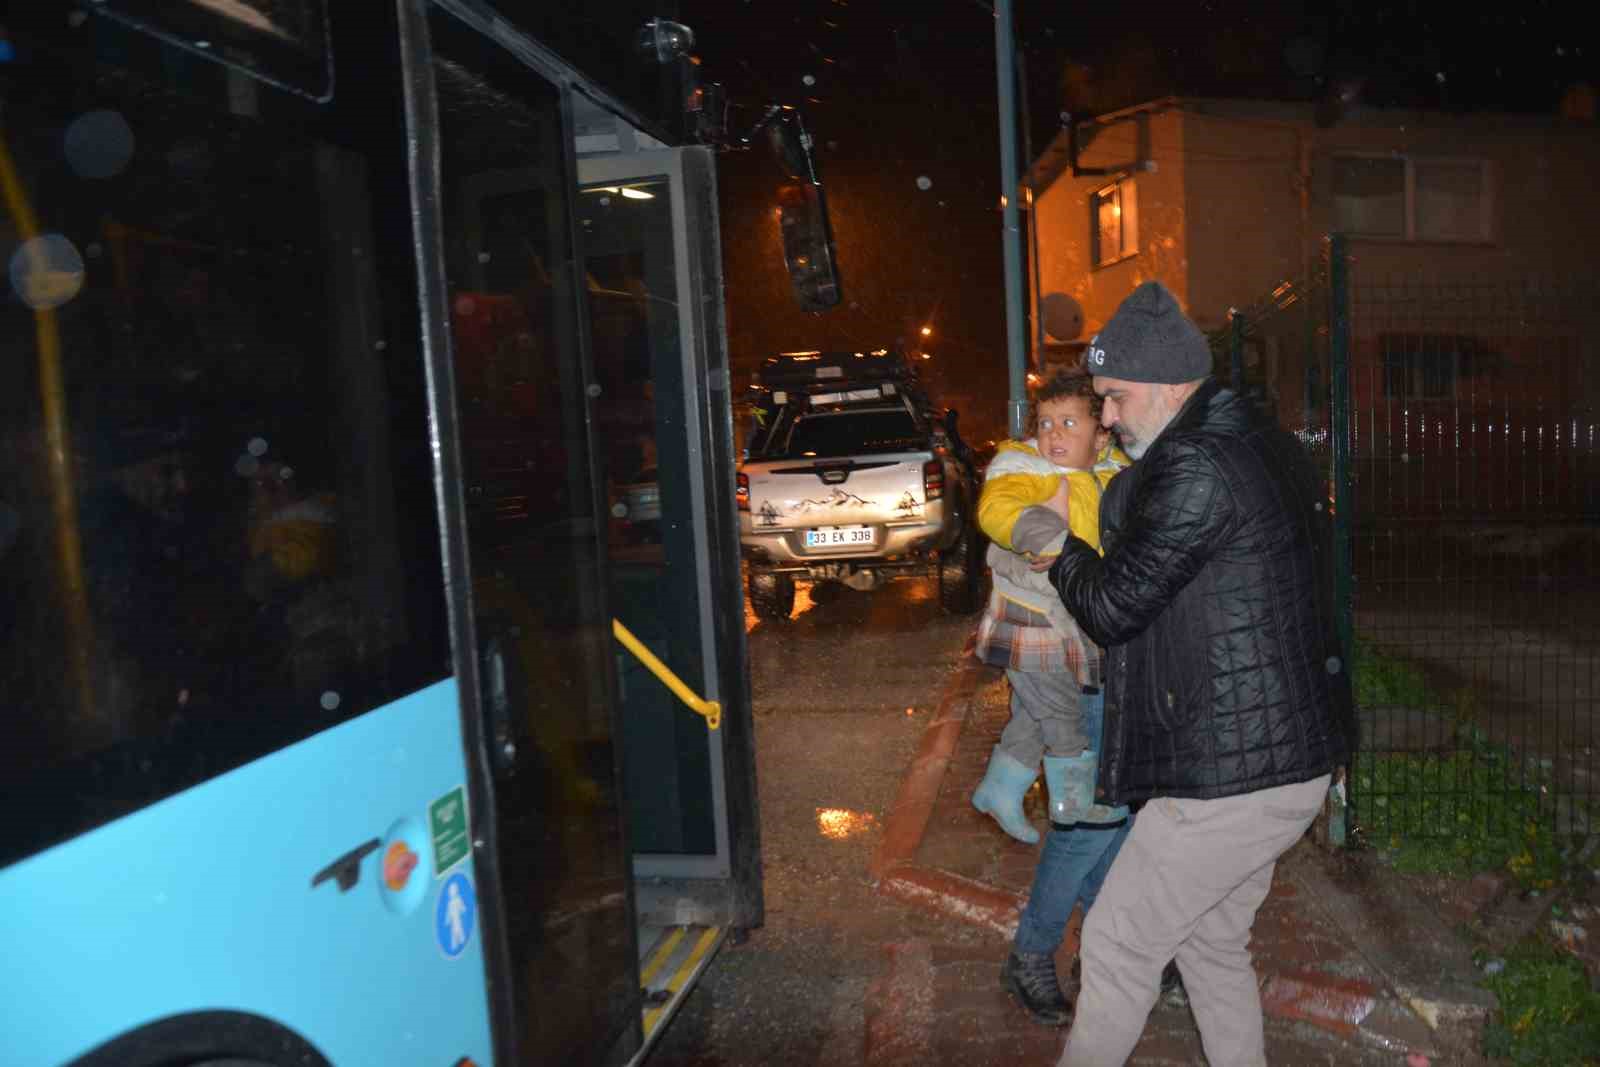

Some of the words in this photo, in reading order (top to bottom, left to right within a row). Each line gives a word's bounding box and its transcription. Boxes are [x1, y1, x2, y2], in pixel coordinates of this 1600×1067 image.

[814, 533, 826, 543] 33
[832, 532, 845, 542] EK
[851, 530, 871, 541] 338
